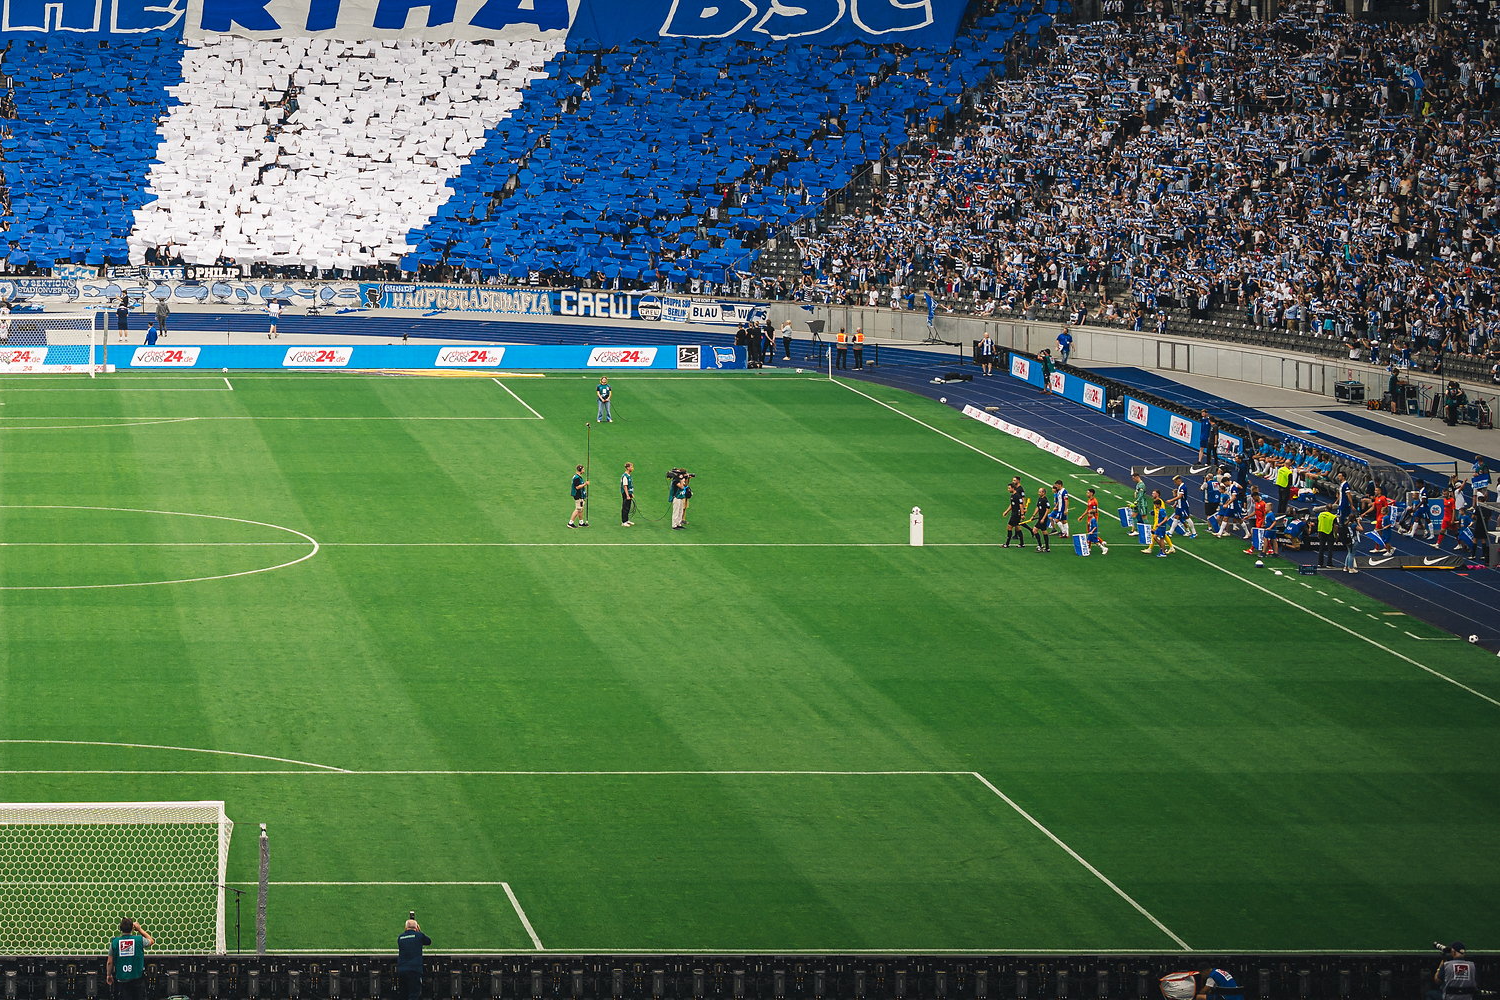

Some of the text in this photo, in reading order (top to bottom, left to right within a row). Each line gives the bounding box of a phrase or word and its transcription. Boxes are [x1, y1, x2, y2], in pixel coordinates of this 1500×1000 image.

[195, 267, 240, 278] PHILIP
[18, 286, 77, 294] STADIONVERBOT
[693, 307, 718, 318] BLAU
